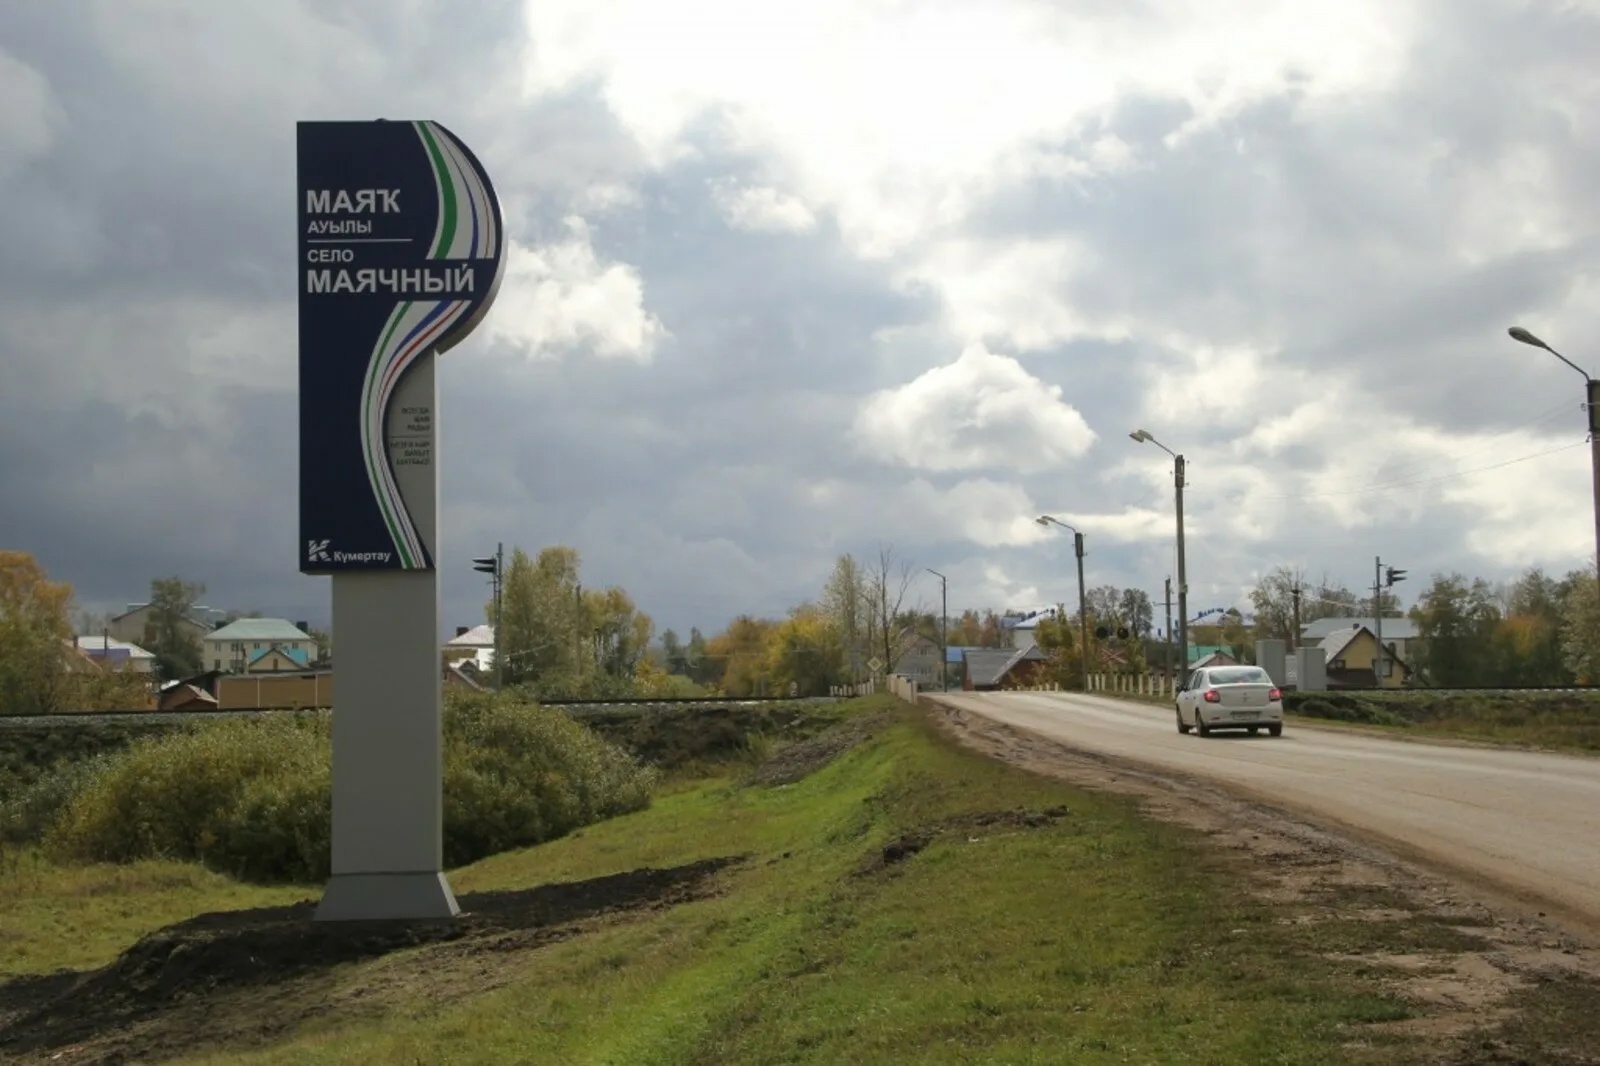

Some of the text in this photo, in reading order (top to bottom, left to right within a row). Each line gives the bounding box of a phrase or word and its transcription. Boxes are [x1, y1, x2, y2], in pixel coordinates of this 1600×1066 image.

[307, 219, 372, 234] АУЫЛЫ
[307, 249, 354, 263] СЕЛО
[306, 264, 474, 293] МАЯЧНЫЙ
